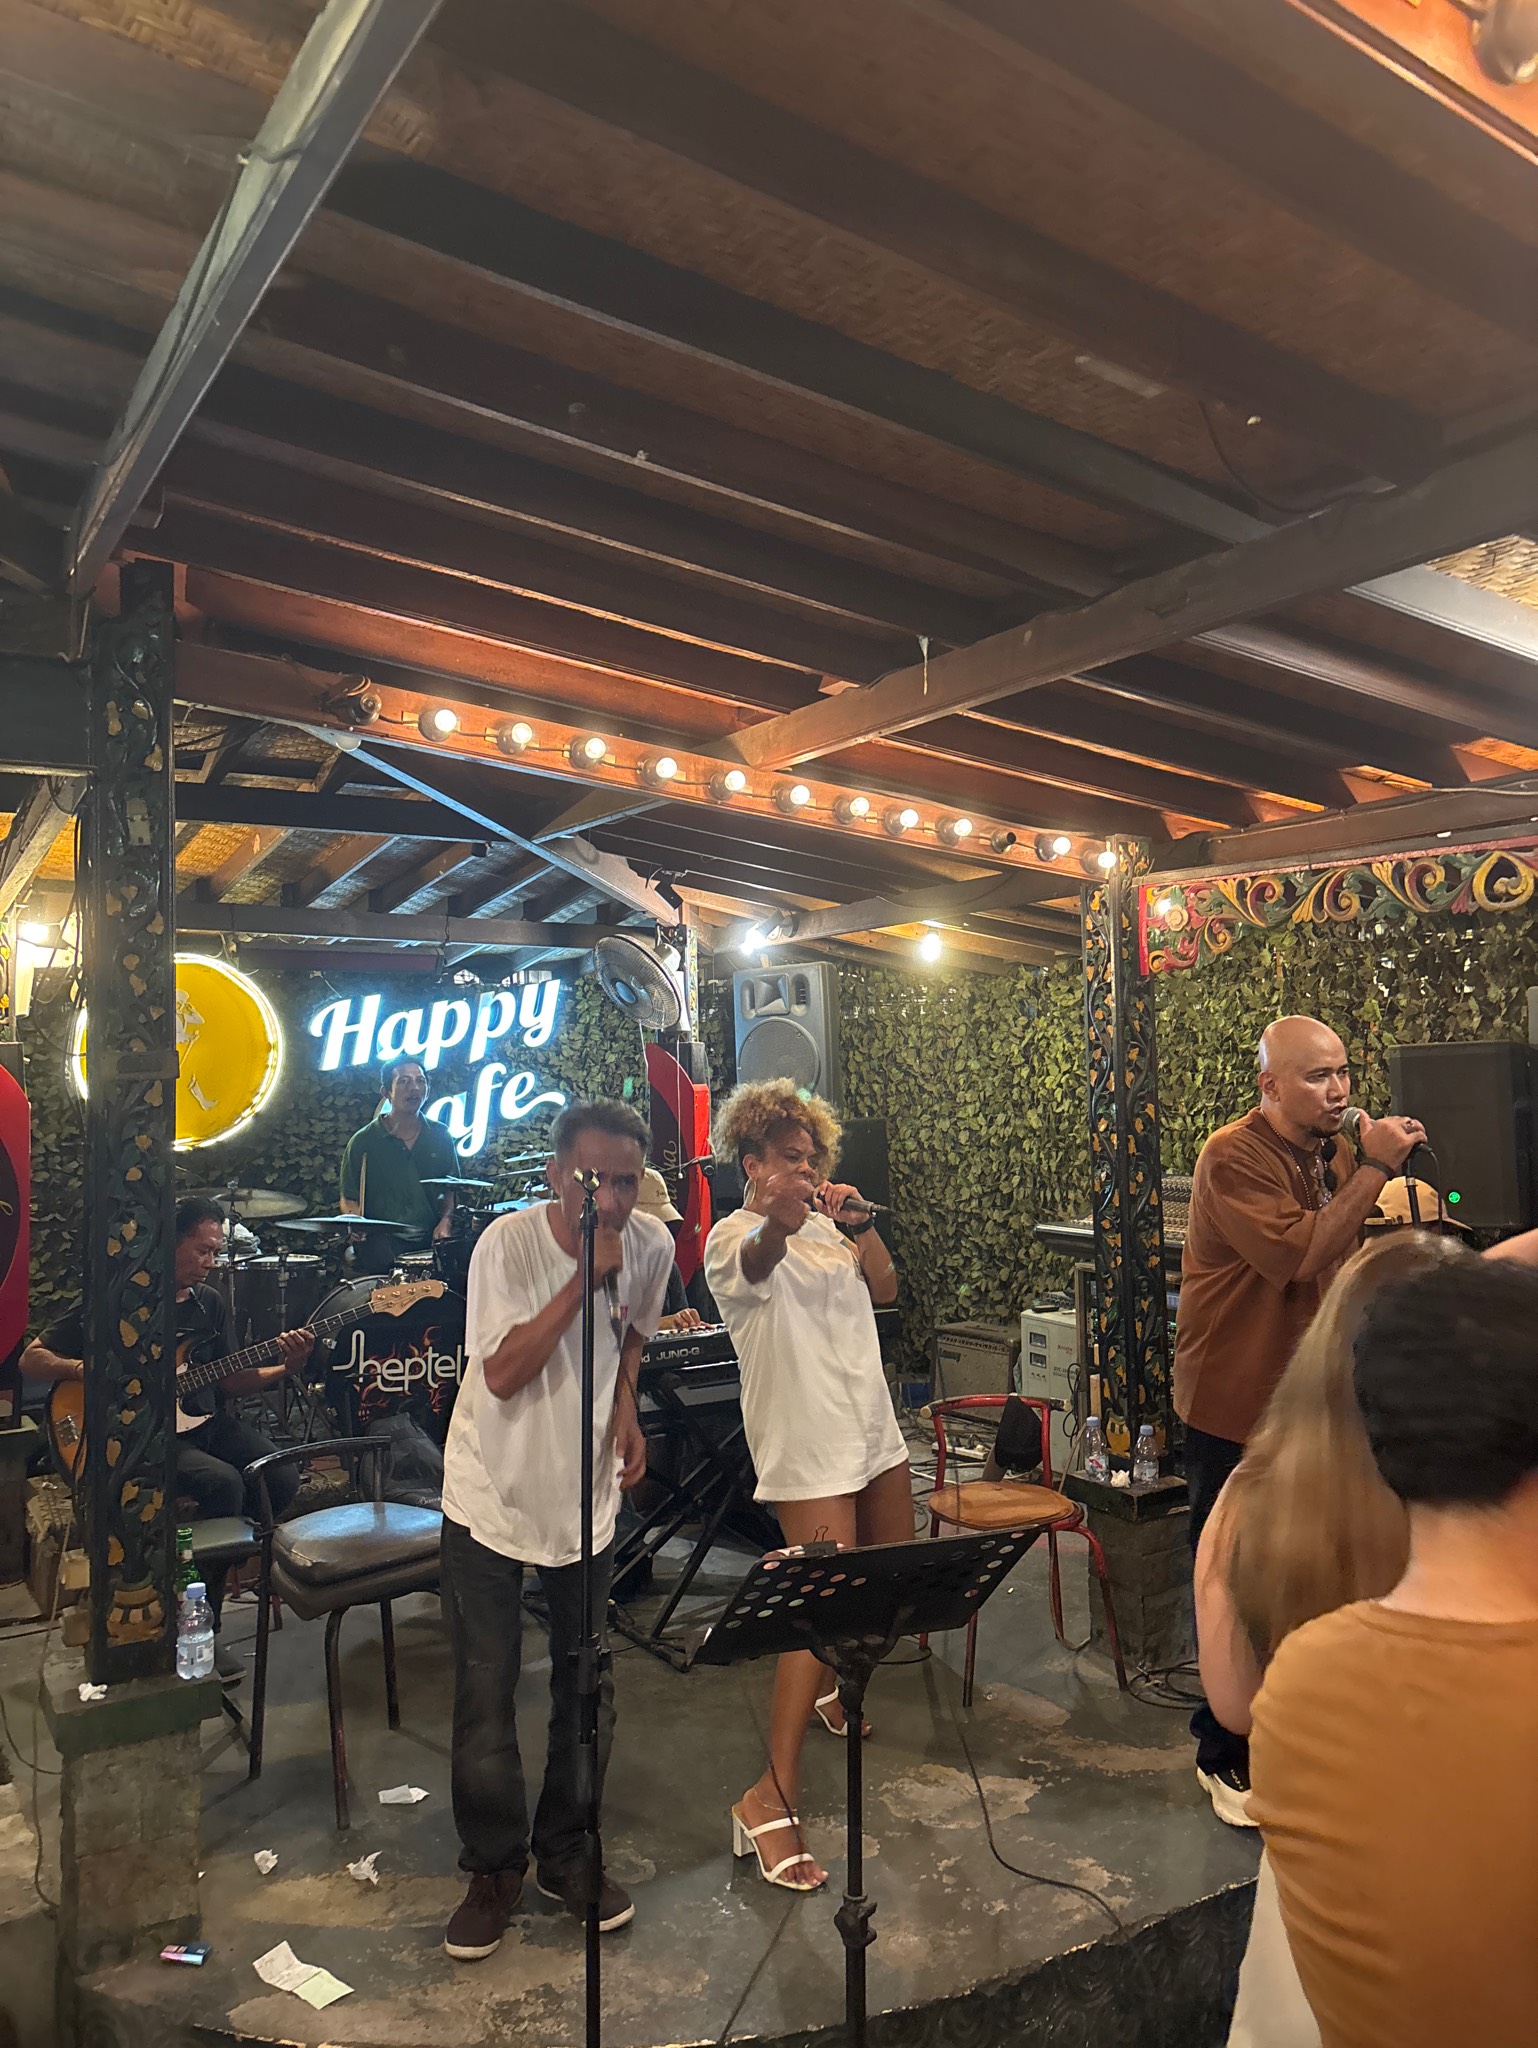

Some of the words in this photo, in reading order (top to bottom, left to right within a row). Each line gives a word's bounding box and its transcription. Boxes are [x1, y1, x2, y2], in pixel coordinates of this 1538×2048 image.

[309, 979, 562, 1071] Happy
[382, 1061, 566, 1158] afe
[655, 1346, 700, 1361] JUNO-G
